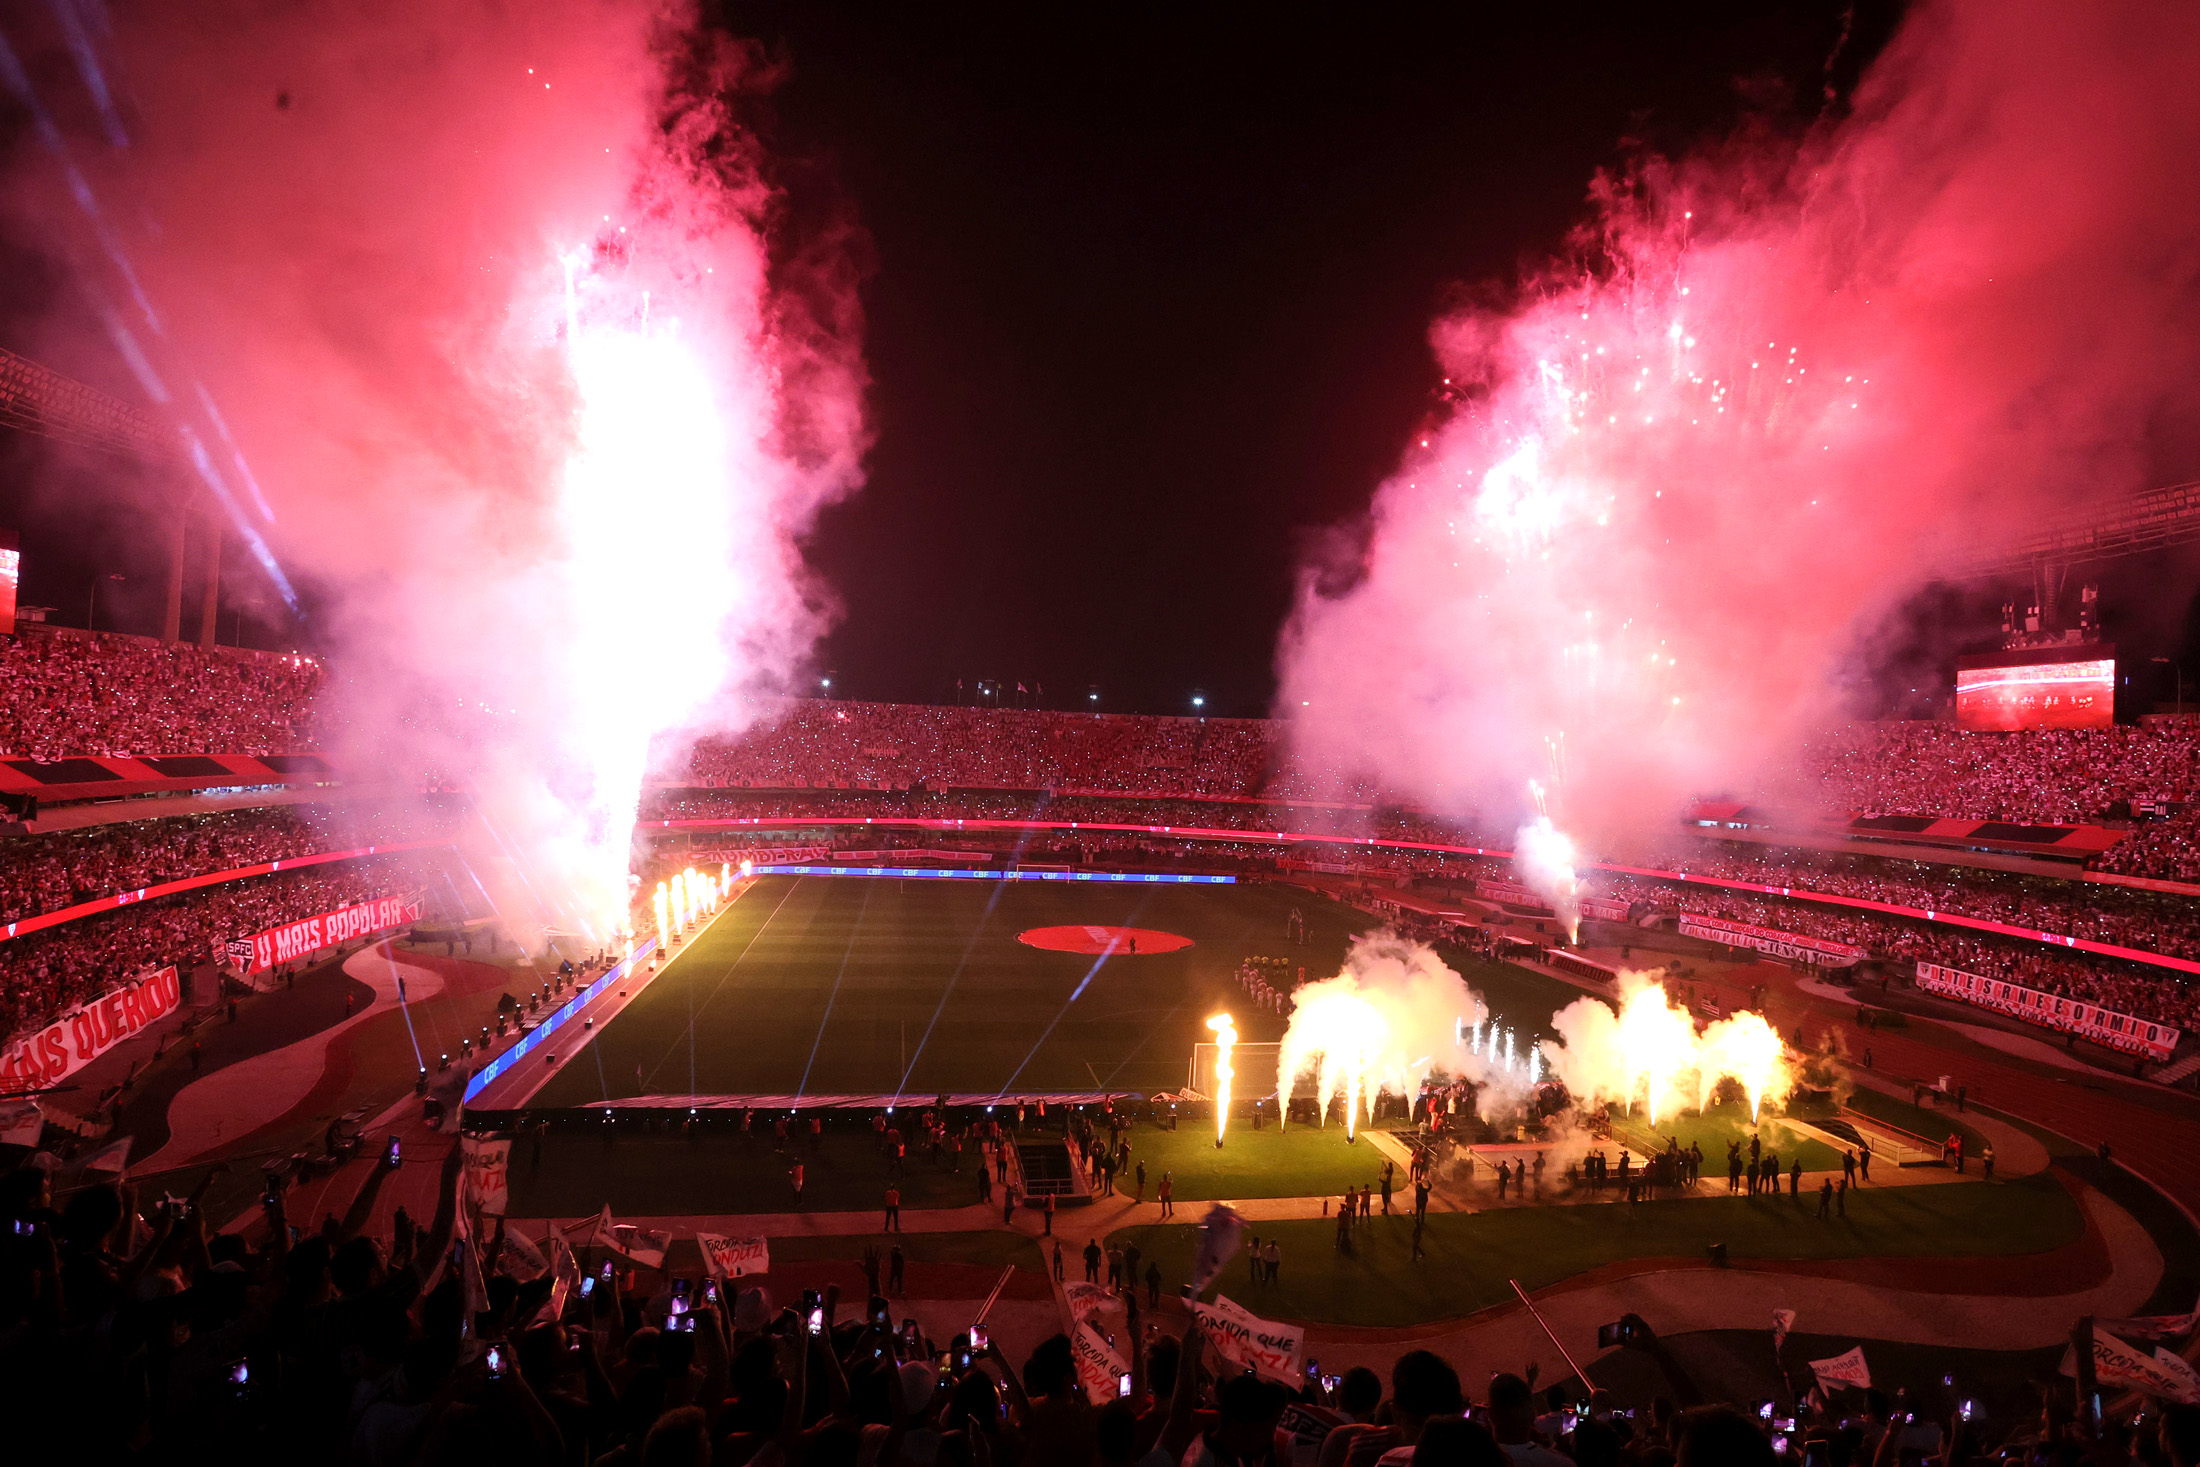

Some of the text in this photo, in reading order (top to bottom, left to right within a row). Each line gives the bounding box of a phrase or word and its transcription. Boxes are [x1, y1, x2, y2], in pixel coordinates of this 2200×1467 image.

[276, 919, 321, 963] MAIS
[326, 899, 401, 944] POPULAR
[228, 942, 252, 955] SPFC
[584, 986, 593, 1003] CBF
[1931, 966, 1973, 989] DENTRE
[1976, 978, 1992, 994] OS
[1993, 983, 2052, 1012] GRANDES
[2074, 1004, 2084, 1020] O
[2086, 1007, 2157, 1042] PRIMEIRO
[72, 967, 179, 1060] QUERIDO
[564, 1002, 574, 1020] CBF
[541, 1018, 553, 1038] CBF
[515, 1036, 528, 1060] CBF
[2080, 1024, 2150, 1060] TORCIDA
[484, 1060, 499, 1084] CBF
[1076, 1332, 1110, 1370] TORCIDA
[1257, 1334, 1295, 1352] QUE
